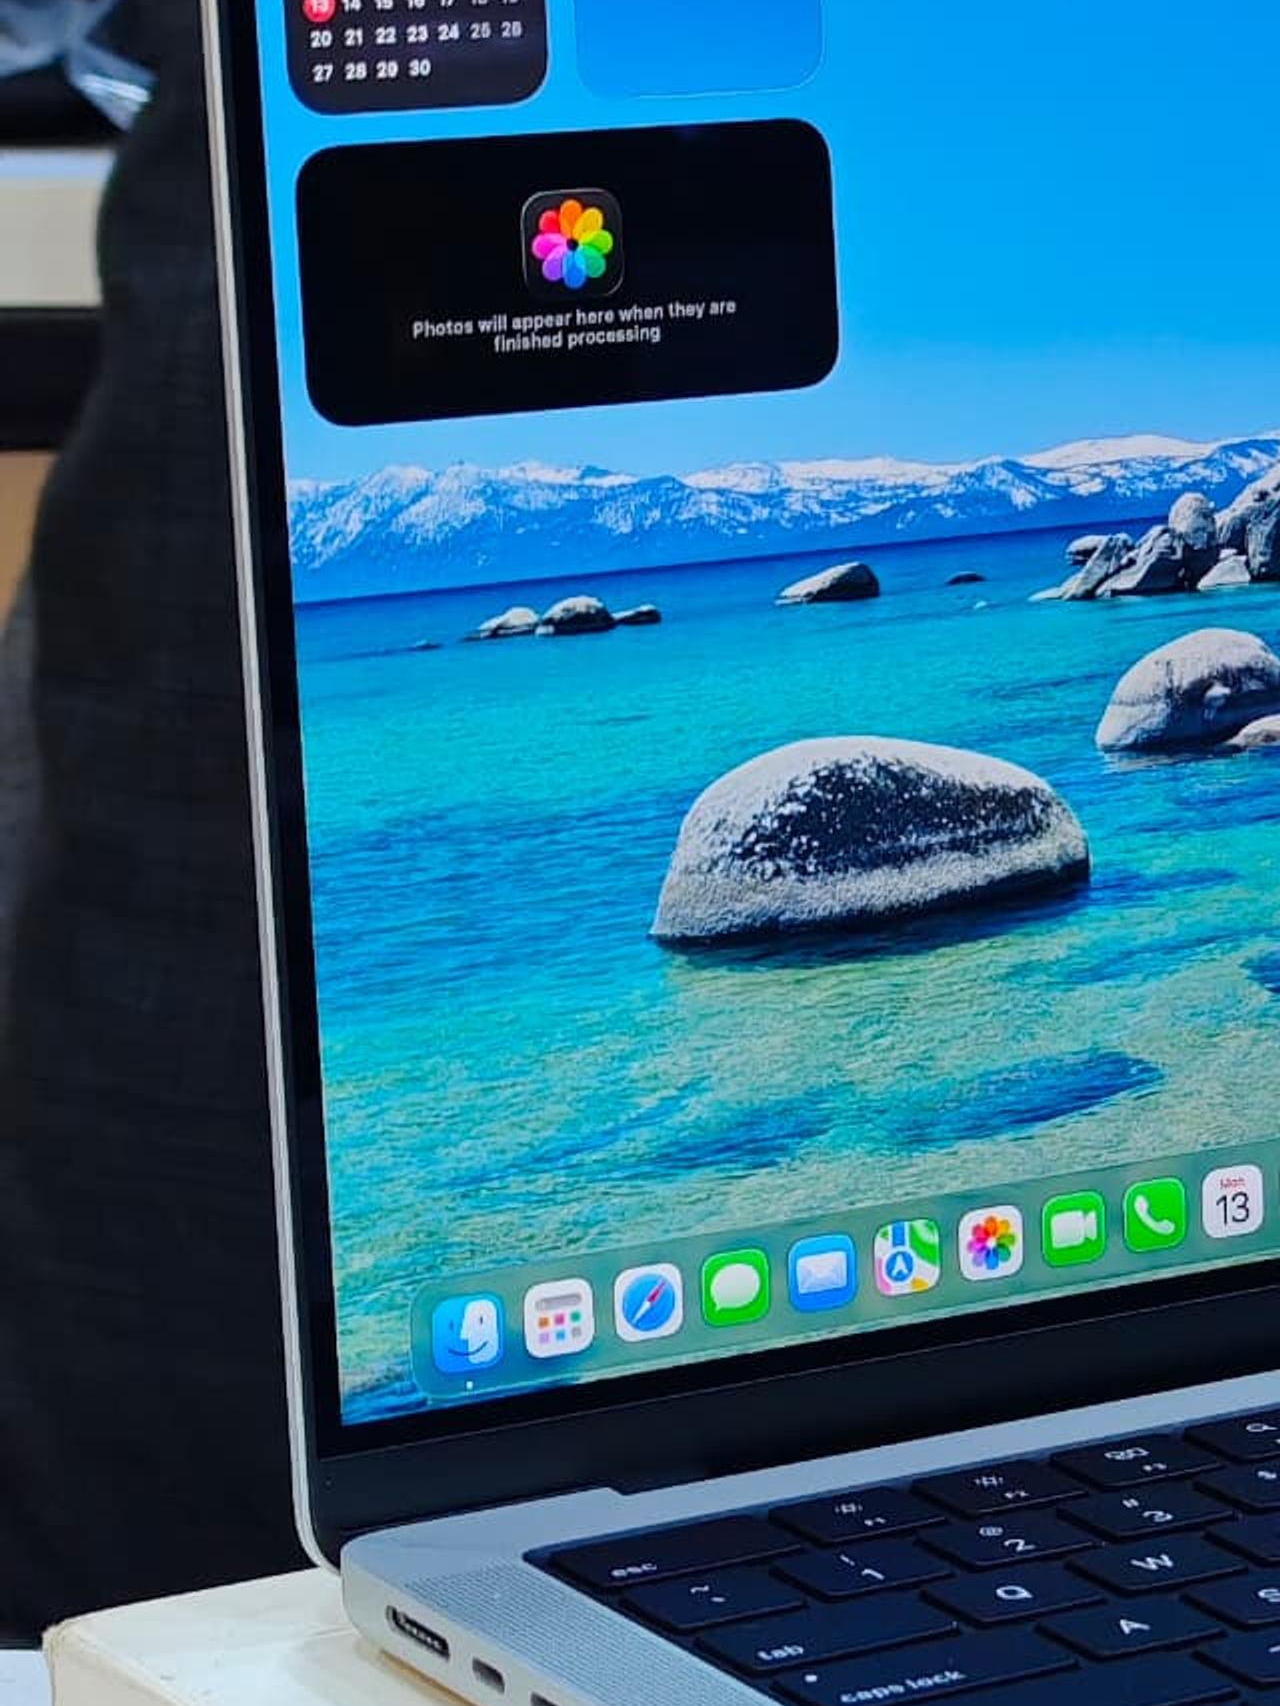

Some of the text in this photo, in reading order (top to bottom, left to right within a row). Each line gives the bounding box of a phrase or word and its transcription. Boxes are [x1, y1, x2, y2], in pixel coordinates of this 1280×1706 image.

[309, 20, 523, 49] 20 21 22 23 24 25 26
[312, 58, 432, 83] 27 28 29 30
[412, 299, 737, 340] Photos will appear here when they are
[493, 325, 662, 353] finished processing
[1215, 1191, 1250, 1227] 13
[1142, 1510, 1174, 1523] 3
[1003, 1538, 1035, 1552] 2
[611, 1562, 658, 1577] esc
[1131, 1553, 1174, 1571] W
[861, 1568, 885, 1580] 1
[995, 1585, 1033, 1600] Q
[1119, 1618, 1150, 1635] A
[757, 1645, 804, 1661] tab
[840, 1670, 966, 1703] caps lock
